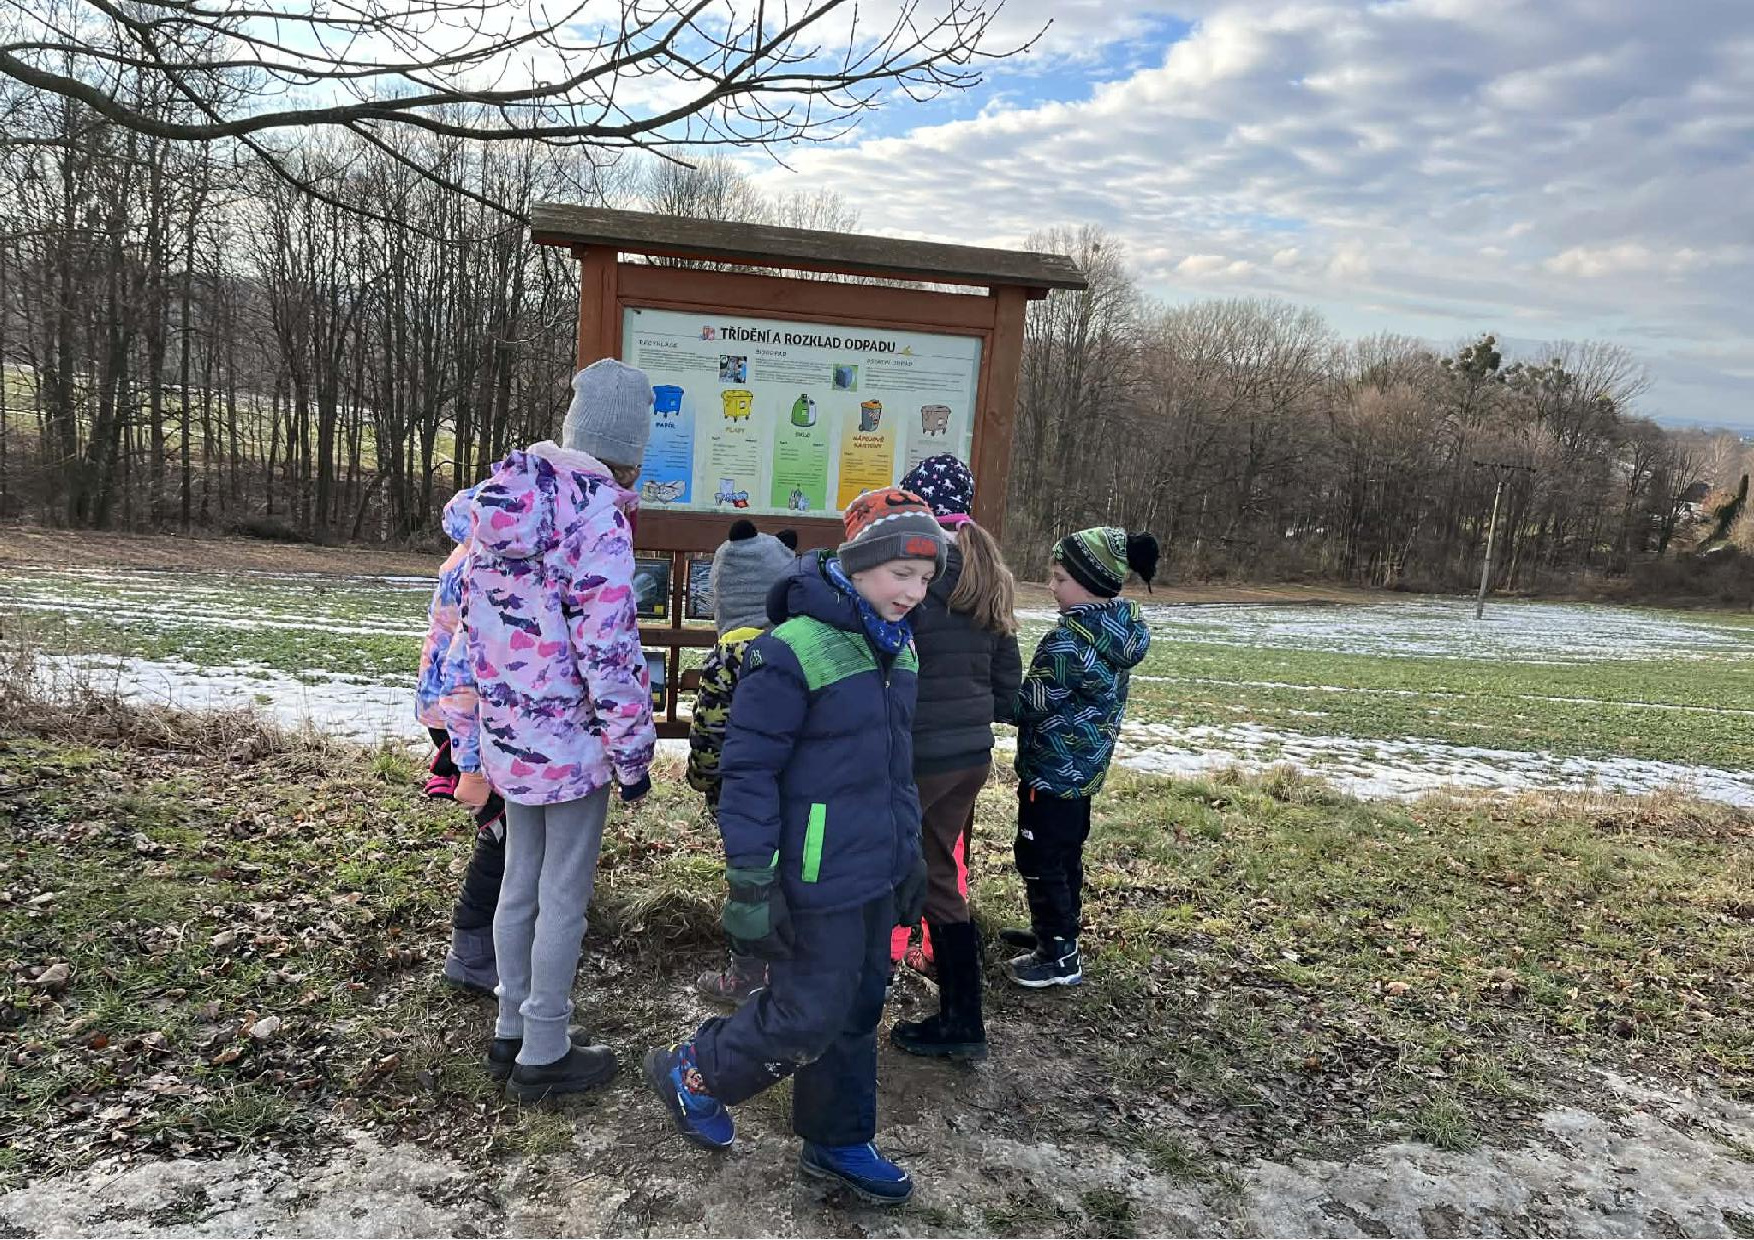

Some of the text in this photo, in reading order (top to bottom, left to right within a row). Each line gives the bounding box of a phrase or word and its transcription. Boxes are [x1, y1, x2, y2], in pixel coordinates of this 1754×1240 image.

[720, 326, 896, 353] TŘÍDĚNÍ A ROZKLAD ODPADU
[655, 421, 676, 429] PAPÍR
